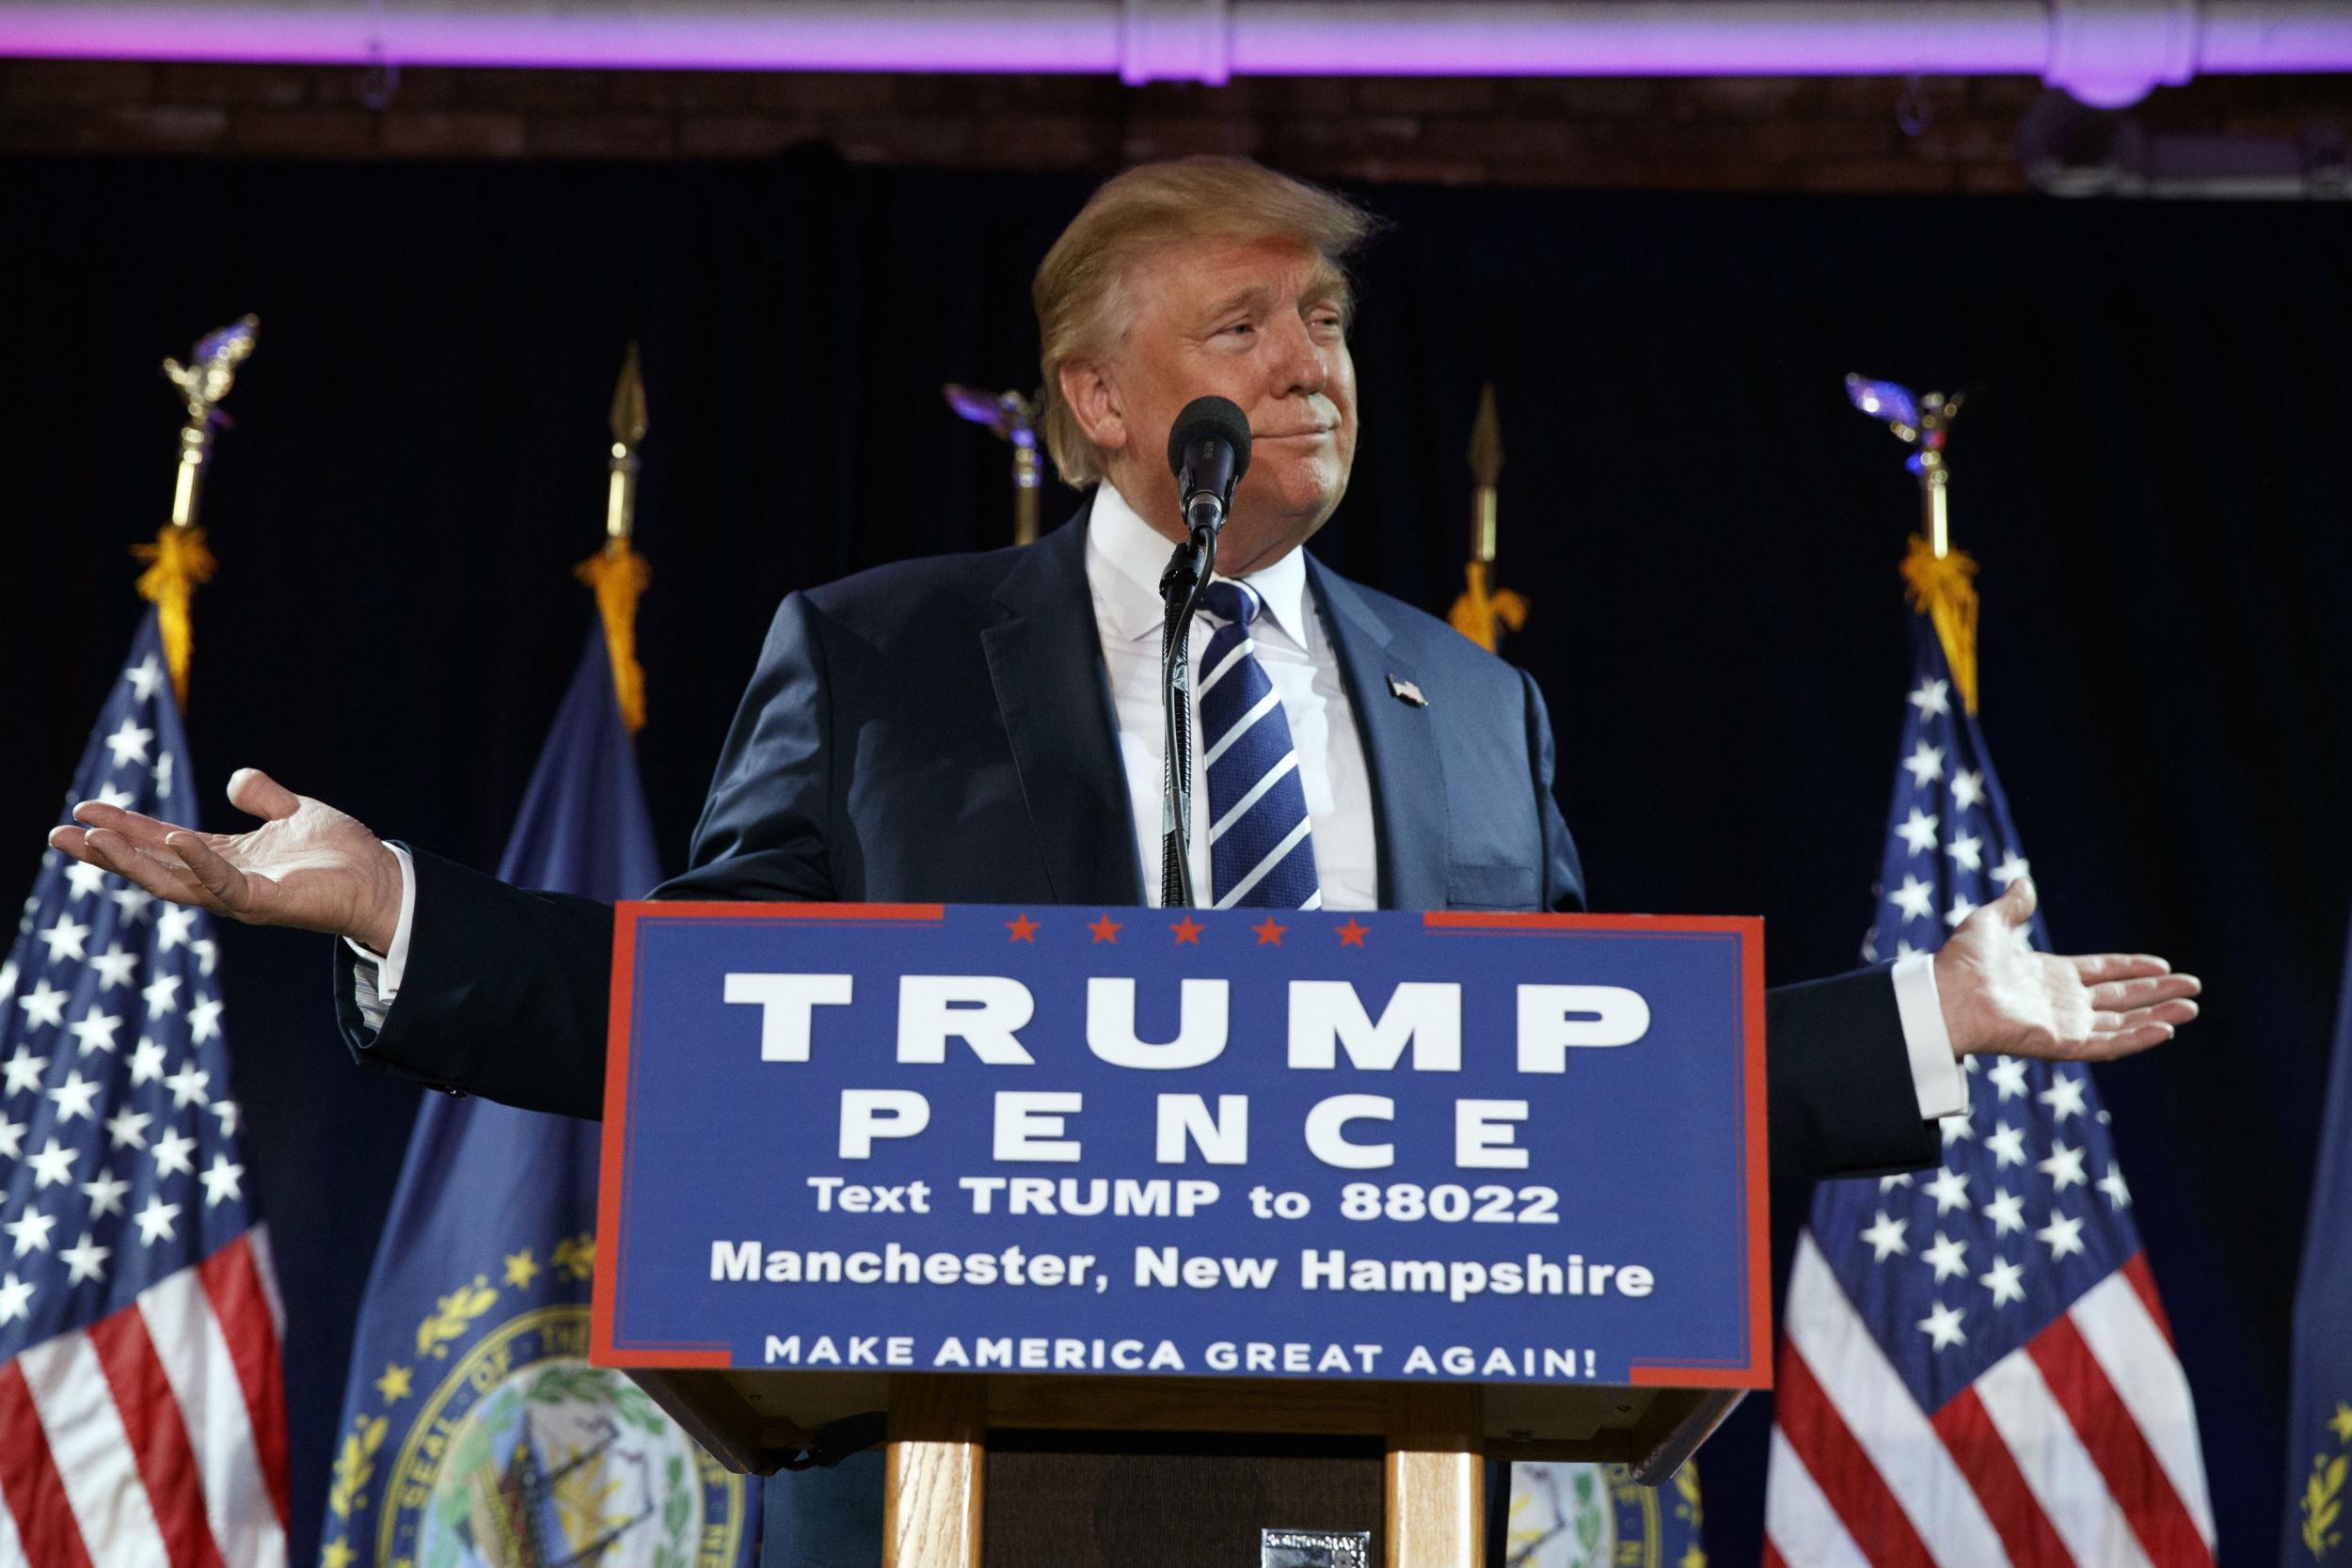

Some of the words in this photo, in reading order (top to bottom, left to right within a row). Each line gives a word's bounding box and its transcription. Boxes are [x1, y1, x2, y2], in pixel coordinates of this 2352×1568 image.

[723, 973, 1651, 1073] TRUMP
[837, 1088, 1530, 1169] PENCE
[806, 1176, 931, 1214] Text
[959, 1176, 1221, 1218] TRUMP
[1248, 1184, 1311, 1220] to
[1340, 1181, 1560, 1225] 88022
[709, 1240, 1109, 1294] Manchester,
[1134, 1245, 1278, 1290] New
[1300, 1248, 1655, 1304] Hampshire
[764, 1334, 914, 1366] MAKE
[933, 1336, 1186, 1371] AMERICA
[1204, 1339, 1384, 1374] GREAT
[1402, 1344, 1597, 1379] AGAIN!
